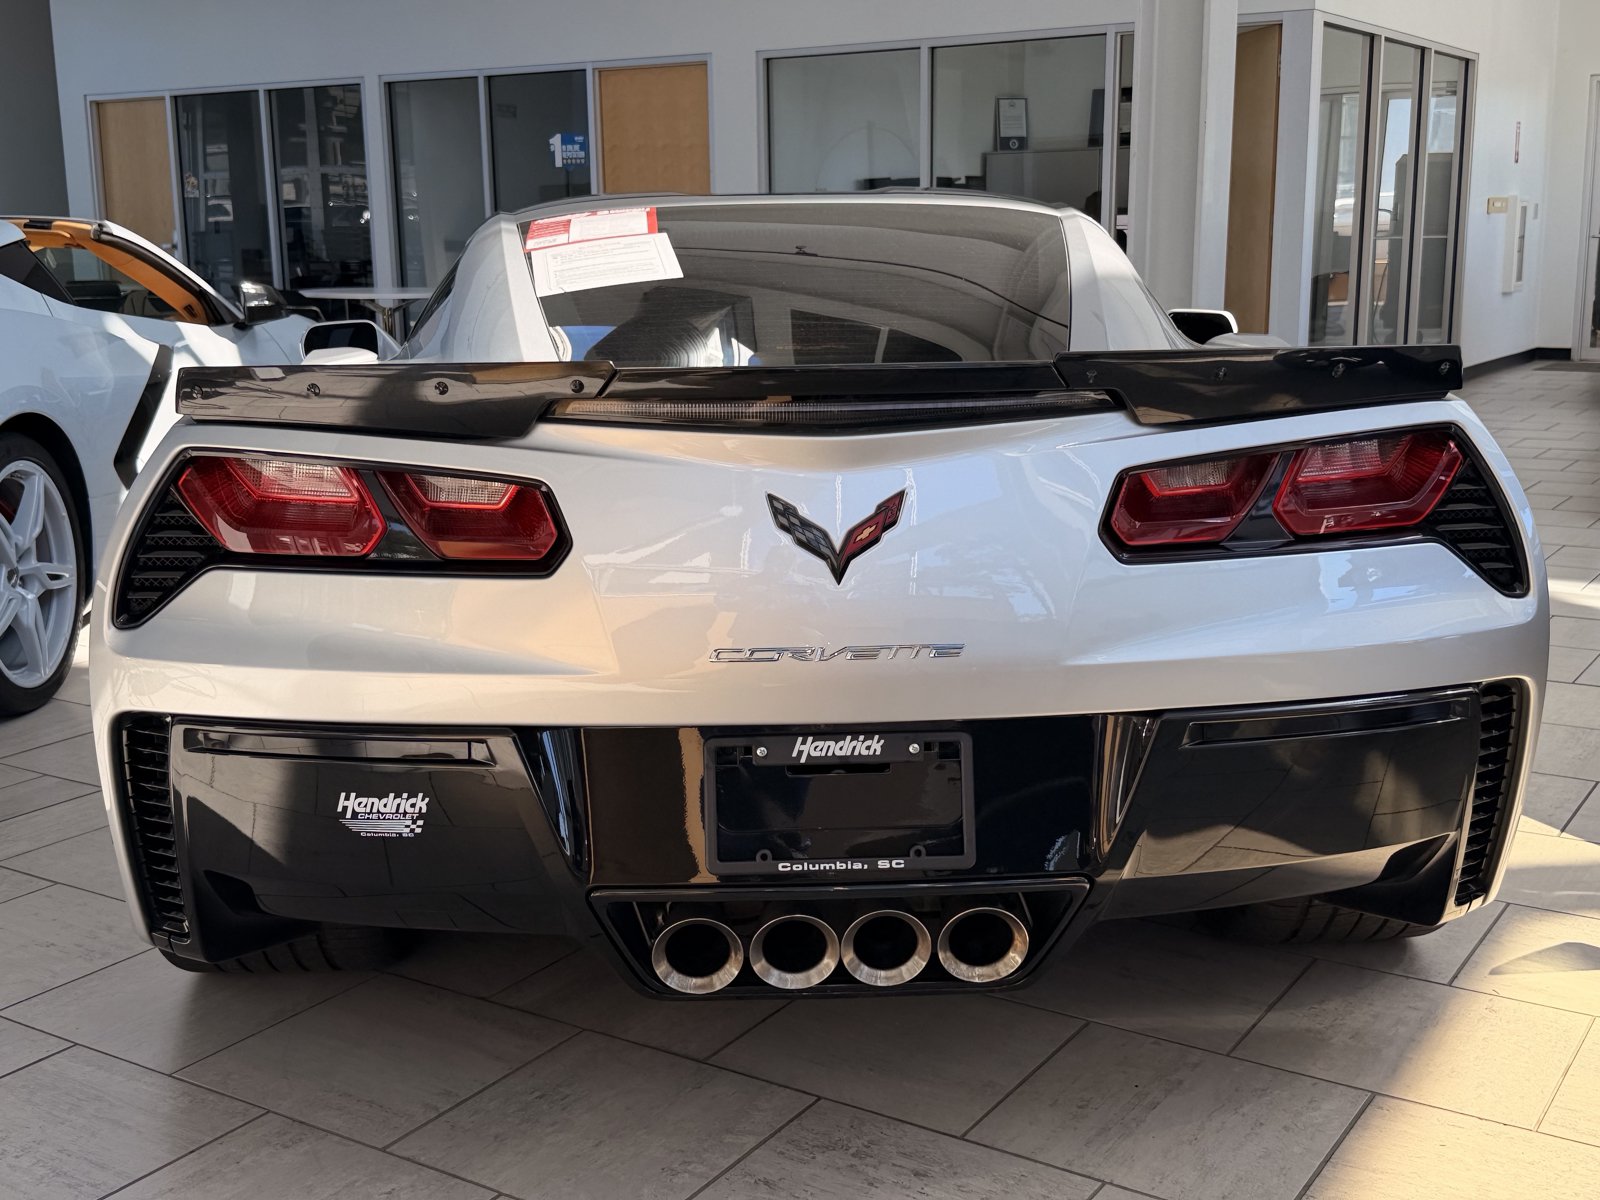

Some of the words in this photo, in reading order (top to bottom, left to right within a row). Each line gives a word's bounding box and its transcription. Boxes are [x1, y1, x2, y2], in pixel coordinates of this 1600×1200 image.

[708, 643, 966, 663] CORVETTE
[791, 735, 885, 763] Hendrick
[336, 791, 430, 819] Hendrick
[777, 860, 869, 872] Columbia,
[877, 858, 906, 870] SC
